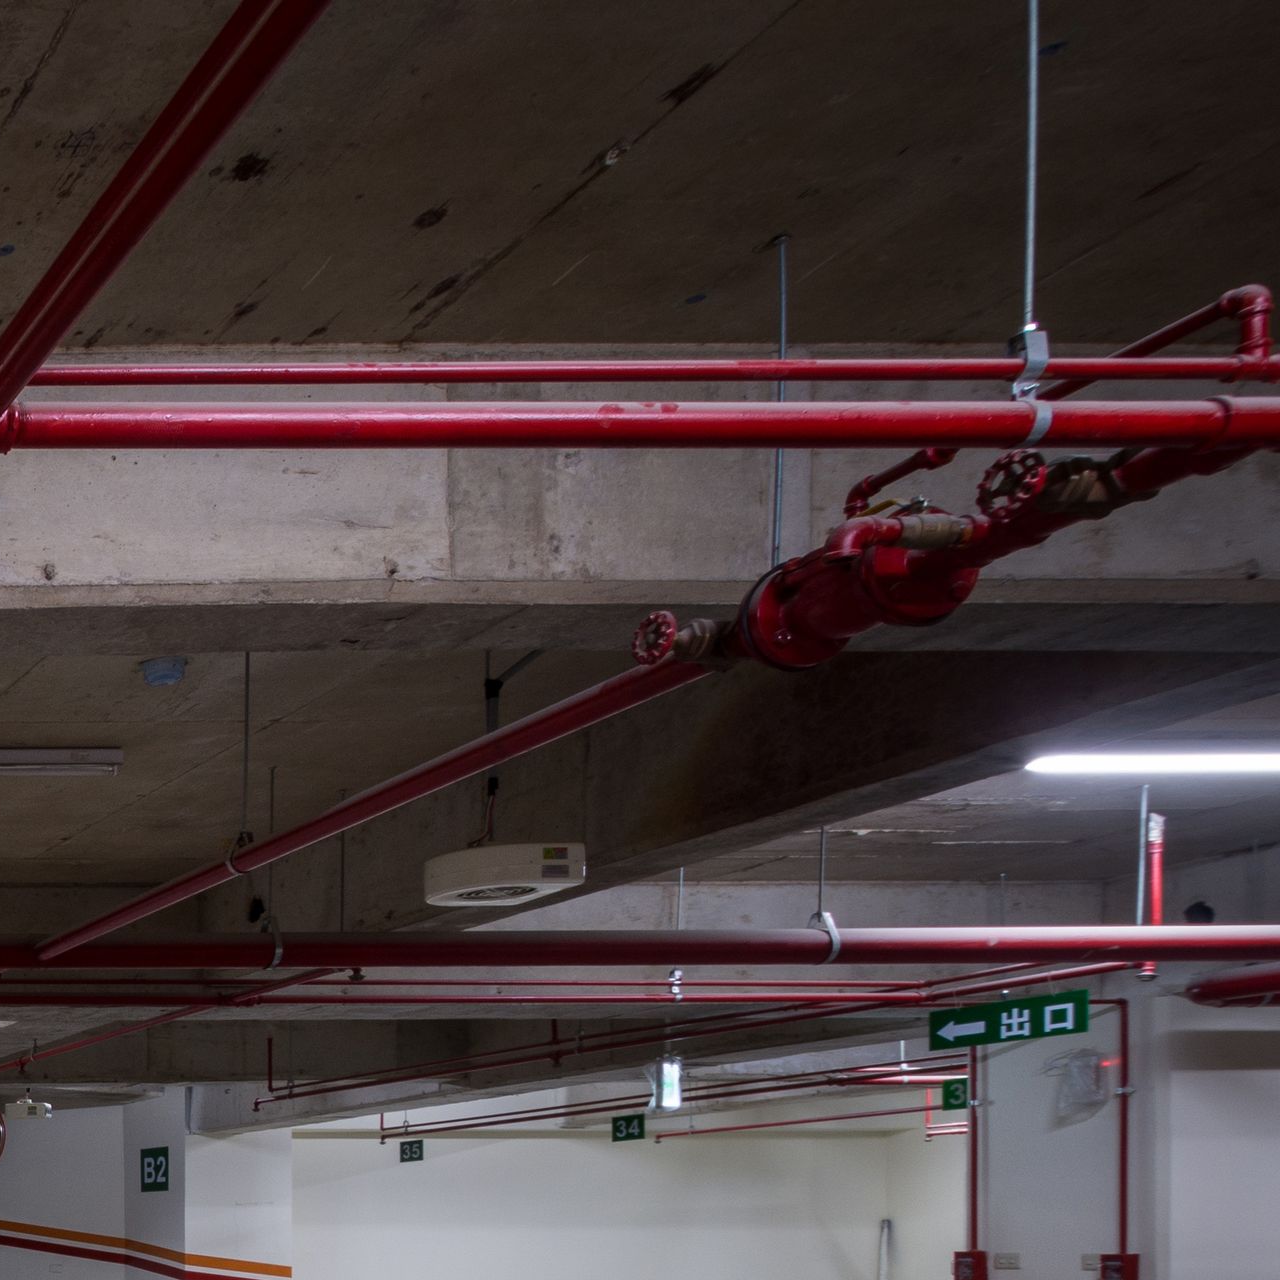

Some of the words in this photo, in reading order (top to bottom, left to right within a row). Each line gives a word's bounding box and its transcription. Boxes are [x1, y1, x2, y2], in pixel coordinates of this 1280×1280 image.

[1000, 1002, 1075, 1040] 出口
[615, 1117, 640, 1138] 34
[402, 1143, 420, 1160] 35
[144, 1156, 167, 1183] B2
